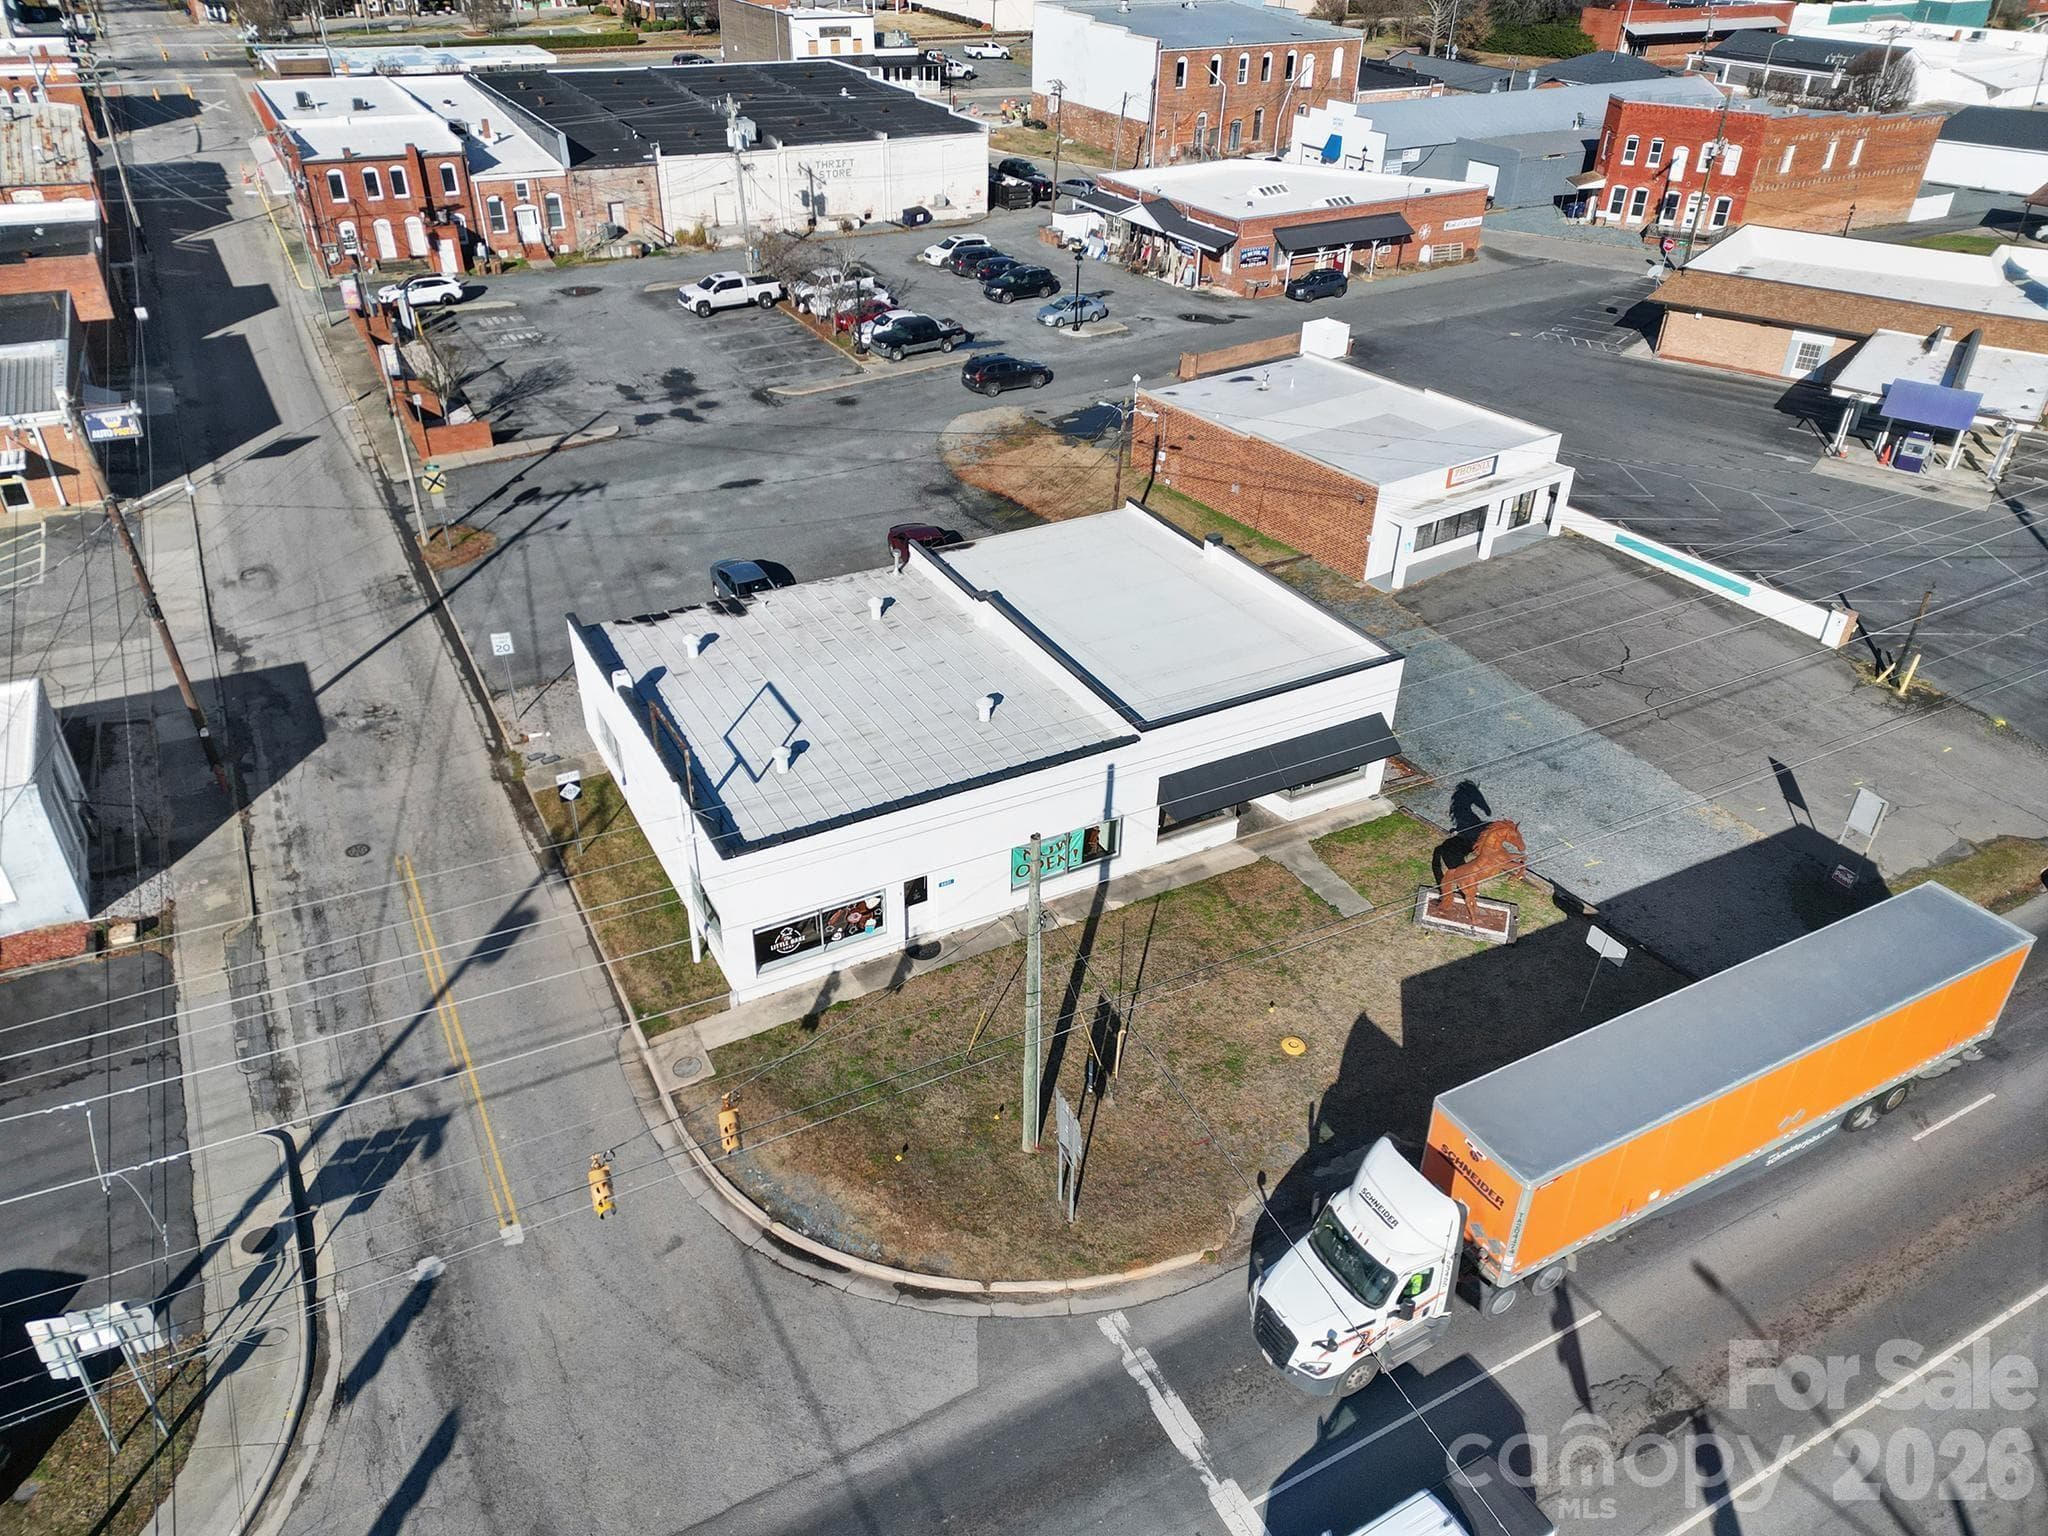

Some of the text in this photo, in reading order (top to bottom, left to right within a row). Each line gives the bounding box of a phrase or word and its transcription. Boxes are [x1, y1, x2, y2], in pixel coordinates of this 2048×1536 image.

[815, 159, 855, 169] THRIFT
[819, 168, 852, 178] STORE
[495, 644, 511, 653] 20
[770, 940, 789, 951] LITTLE
[1440, 1143, 1505, 1208] SCHNEIDER
[1360, 1187, 1399, 1227] SCHNEIDER
